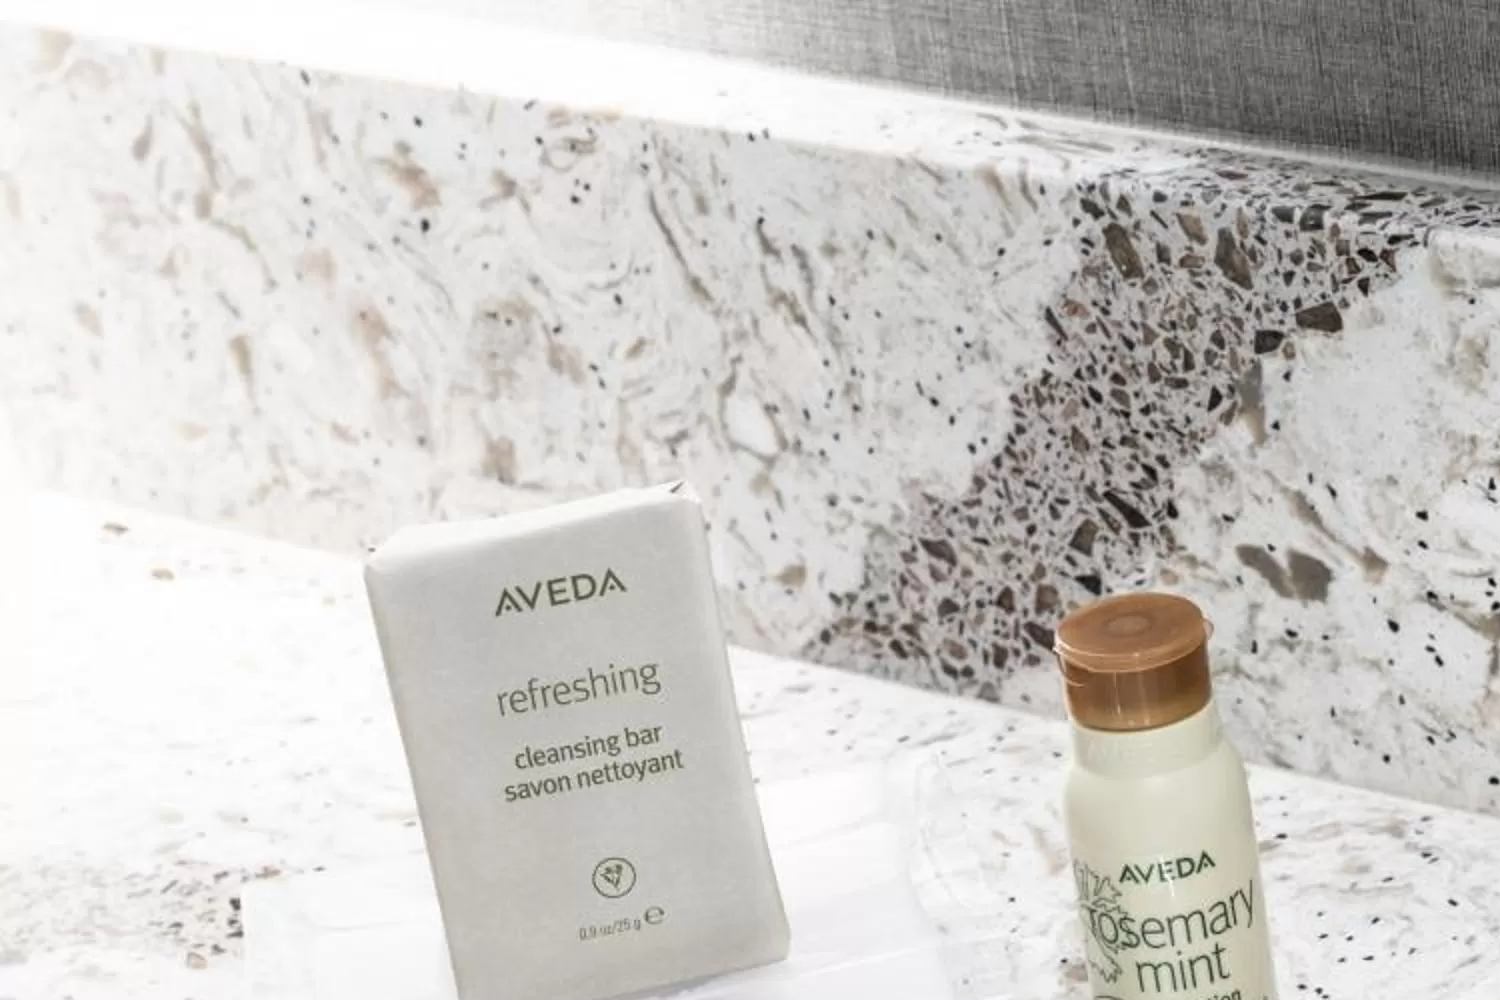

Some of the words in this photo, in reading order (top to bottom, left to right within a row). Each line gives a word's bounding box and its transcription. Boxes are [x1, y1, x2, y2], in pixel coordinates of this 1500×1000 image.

[495, 568, 627, 617] AVEDA
[497, 663, 662, 717] refreshing
[514, 735, 621, 770] cleansing
[624, 725, 663, 748] bar
[504, 772, 572, 803] savon
[577, 749, 684, 789] nettoyant
[1119, 849, 1216, 884] AVEDA
[1135, 941, 1231, 993] mint
